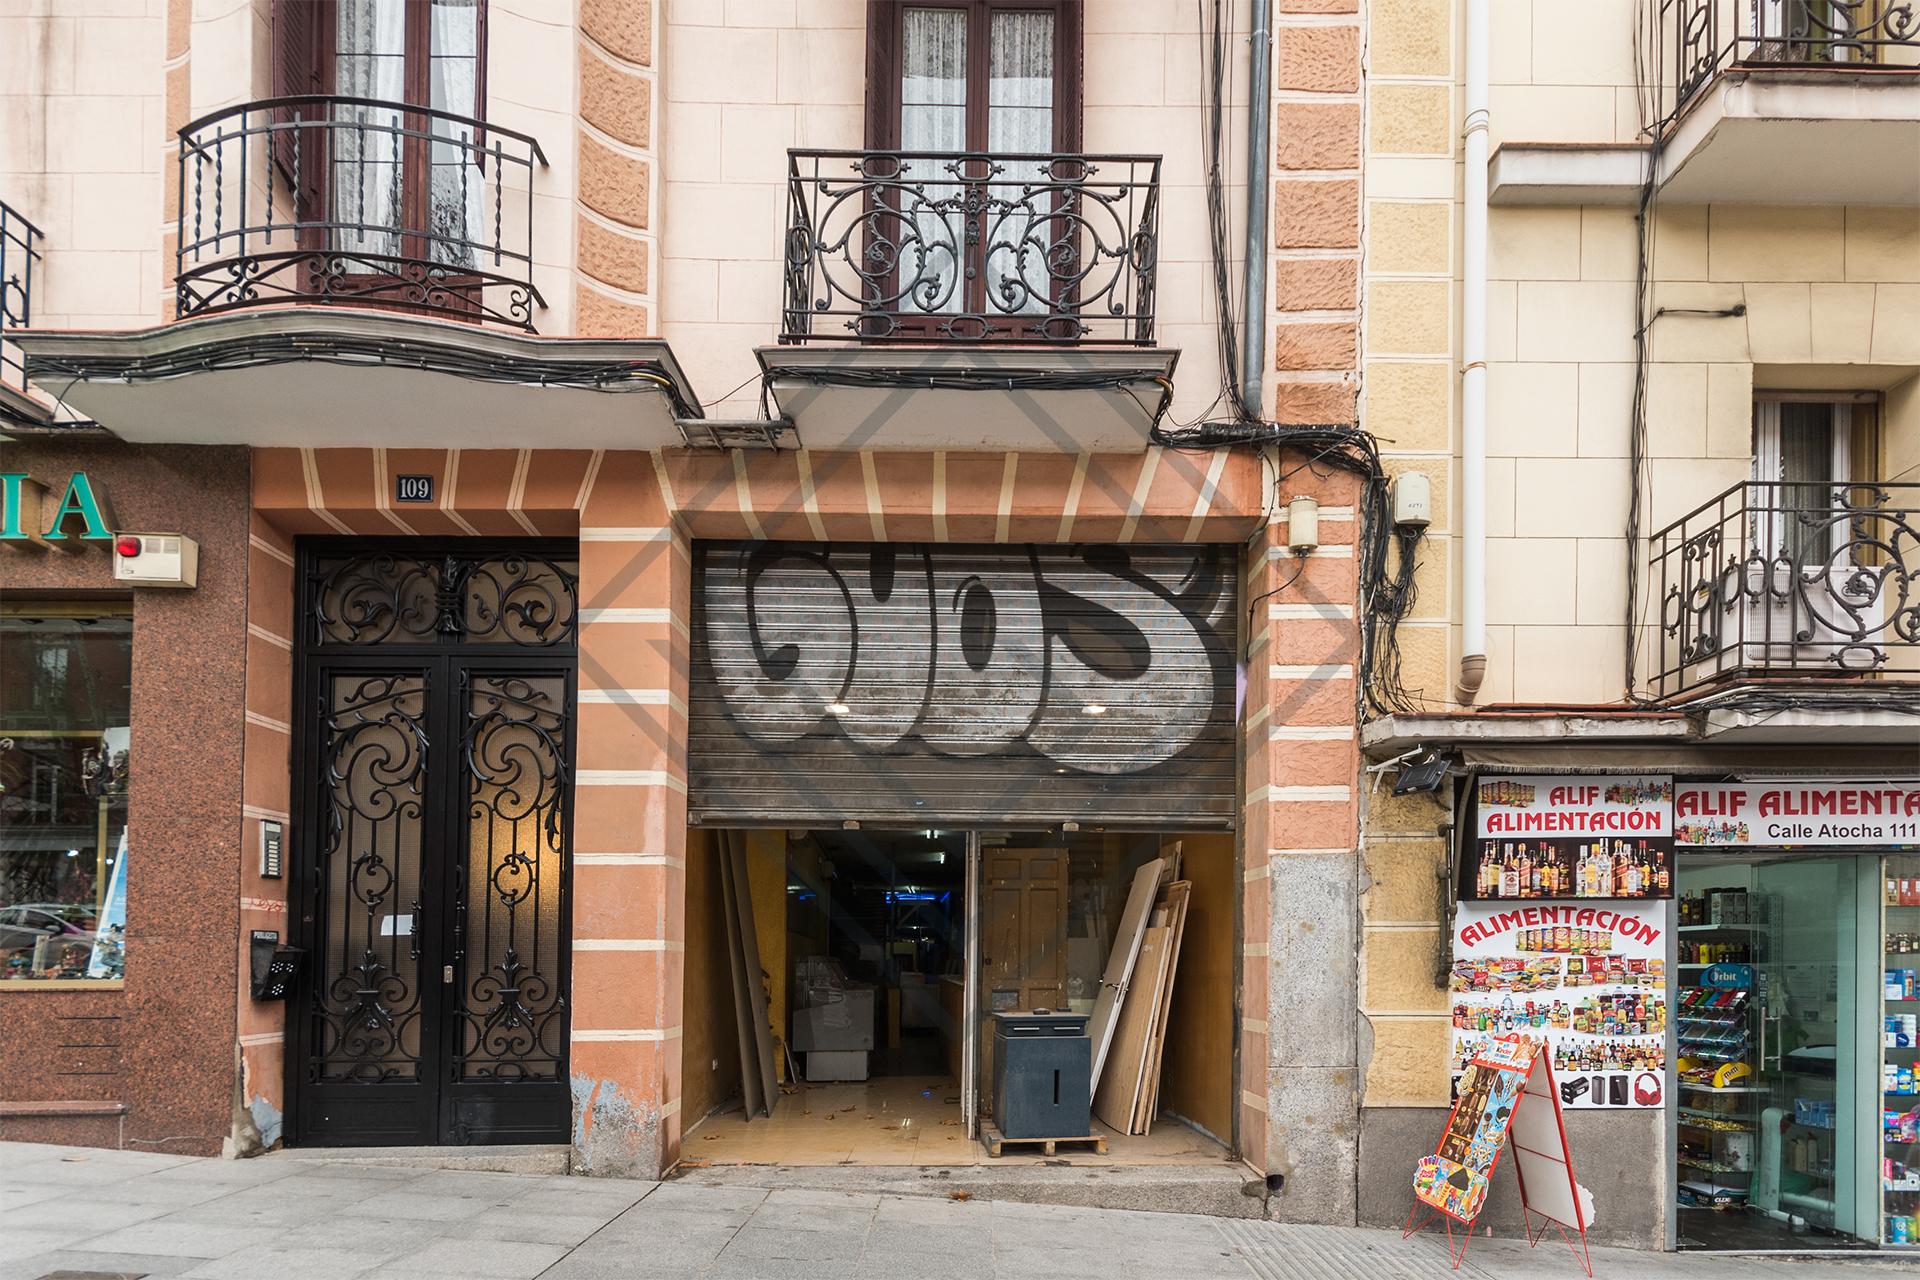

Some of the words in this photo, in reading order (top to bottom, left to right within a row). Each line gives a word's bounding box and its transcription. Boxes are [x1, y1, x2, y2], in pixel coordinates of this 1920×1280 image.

[401, 478, 429, 498] 109
[1550, 786, 1600, 807] ALIF
[1676, 790, 1748, 818] ALIF
[1758, 790, 1920, 818] ALIMENTA
[1487, 808, 1661, 833] ALIMENTACIÓN
[1767, 823, 1813, 838] Calle
[1818, 823, 1883, 838] Atocha
[1889, 823, 1917, 838] 111
[1460, 906, 1661, 948] ALIMENTACIÓN
[1709, 967, 1737, 983] Orbit
